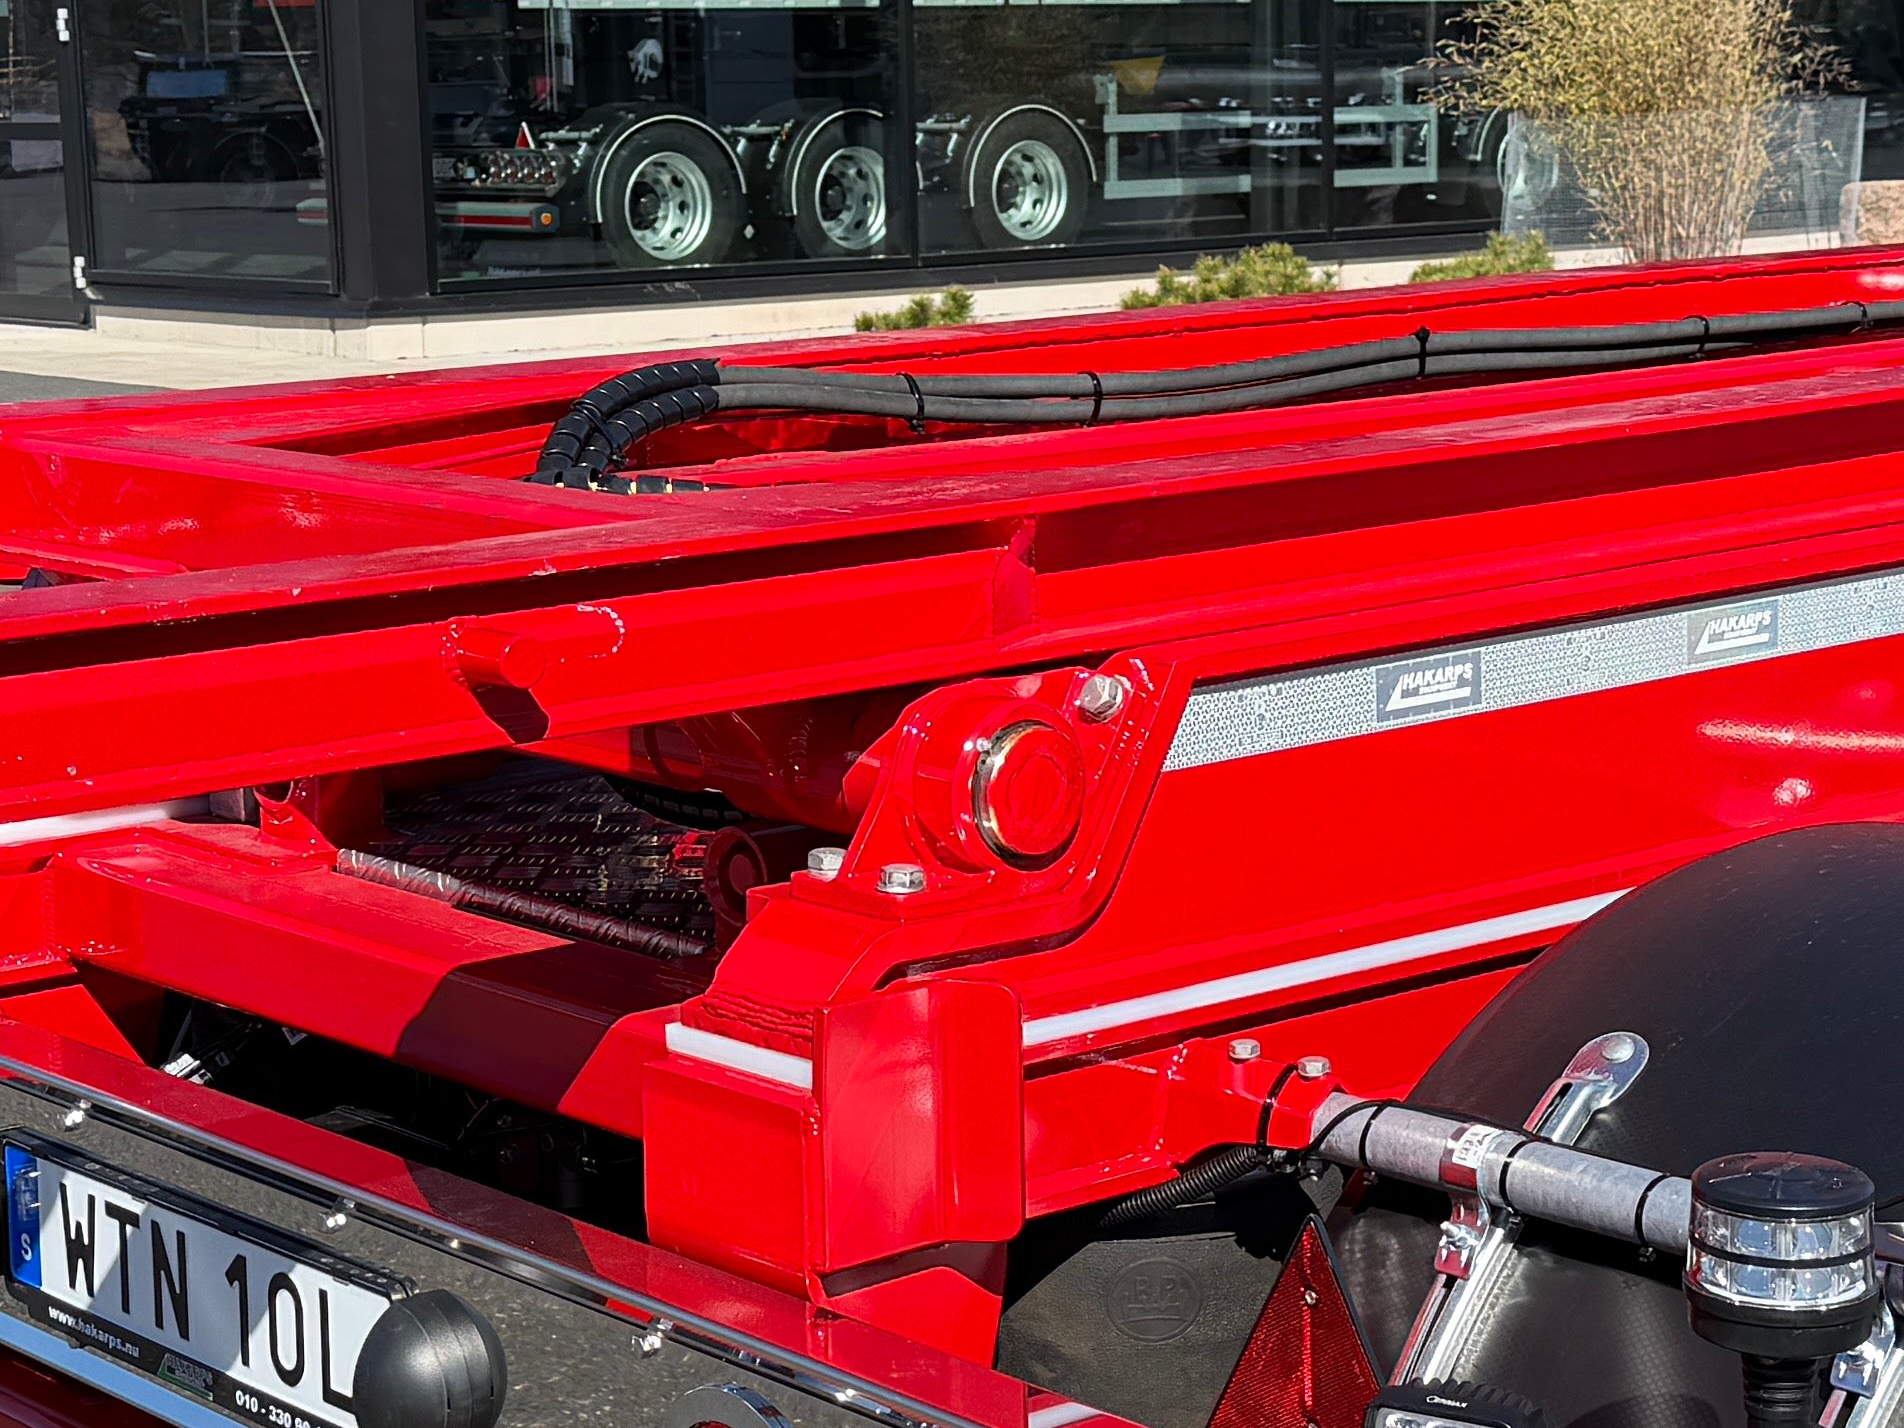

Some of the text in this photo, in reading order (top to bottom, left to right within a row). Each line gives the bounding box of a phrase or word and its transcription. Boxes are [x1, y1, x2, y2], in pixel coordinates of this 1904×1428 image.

[1402, 662, 1474, 690] HAKARPS
[20, 1232, 33, 1262] S
[59, 1180, 191, 1342] WTN
[47, 1304, 140, 1358] www.hakarps.nu
[235, 1389, 258, 1414] 010
